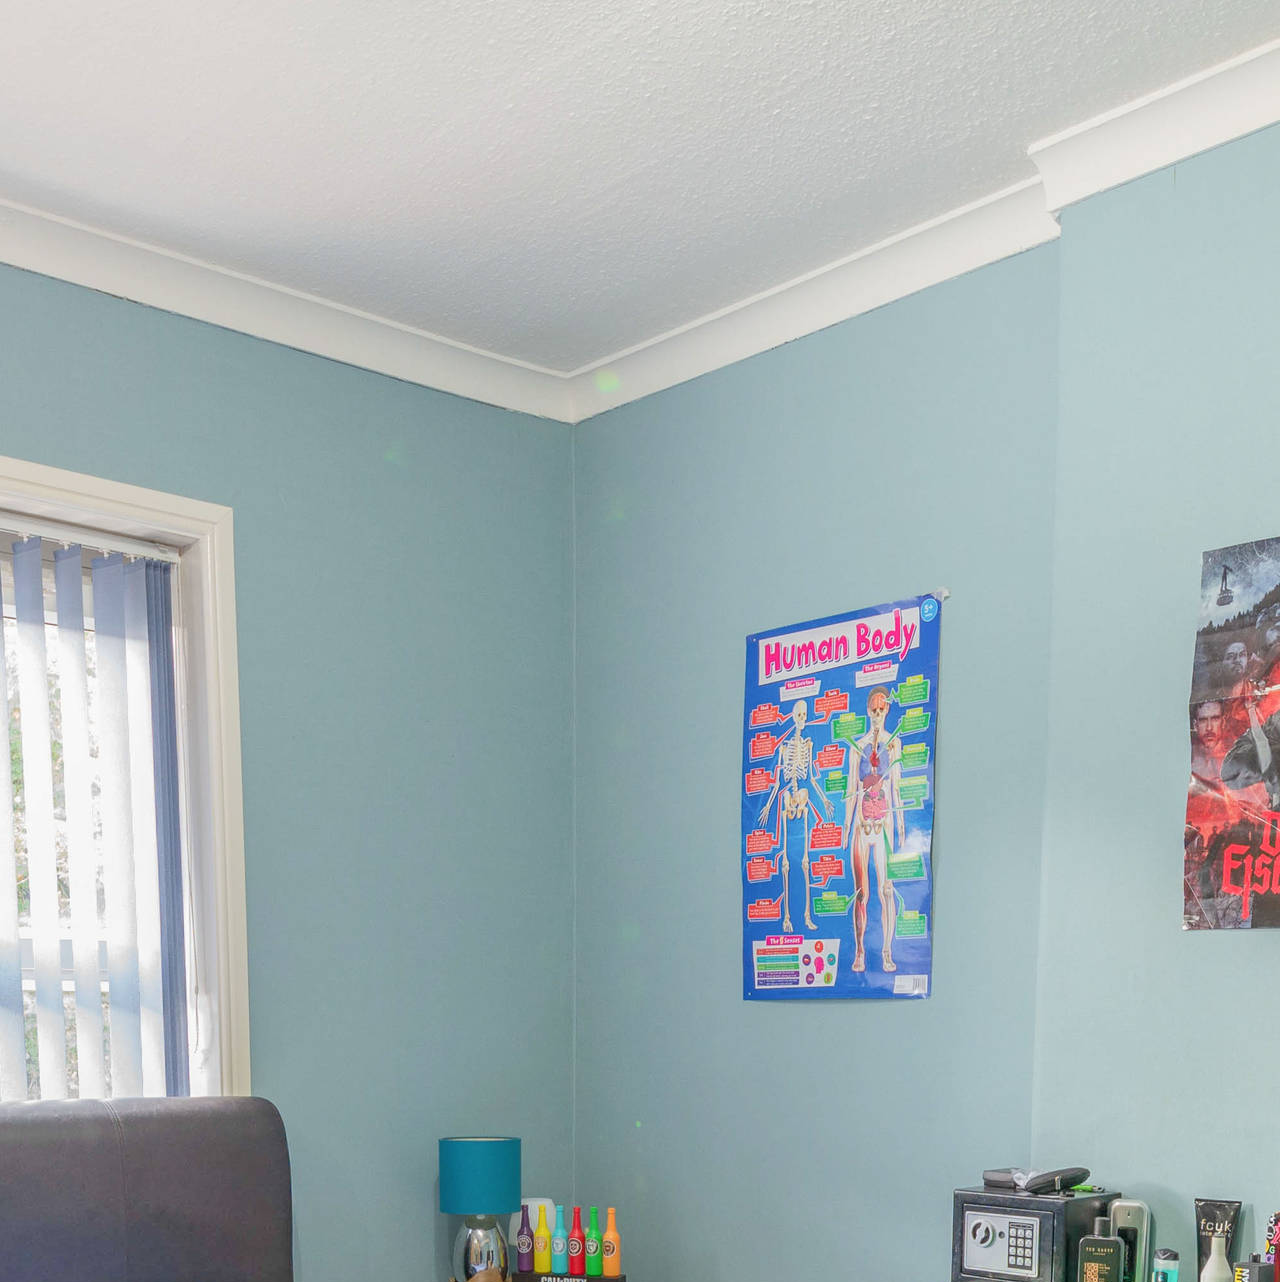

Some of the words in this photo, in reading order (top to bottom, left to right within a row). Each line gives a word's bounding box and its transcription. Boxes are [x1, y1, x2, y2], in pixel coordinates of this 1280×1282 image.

[764, 634, 849, 677] Human
[856, 608, 917, 661] Body
[1201, 1218, 1232, 1234] fcuk
